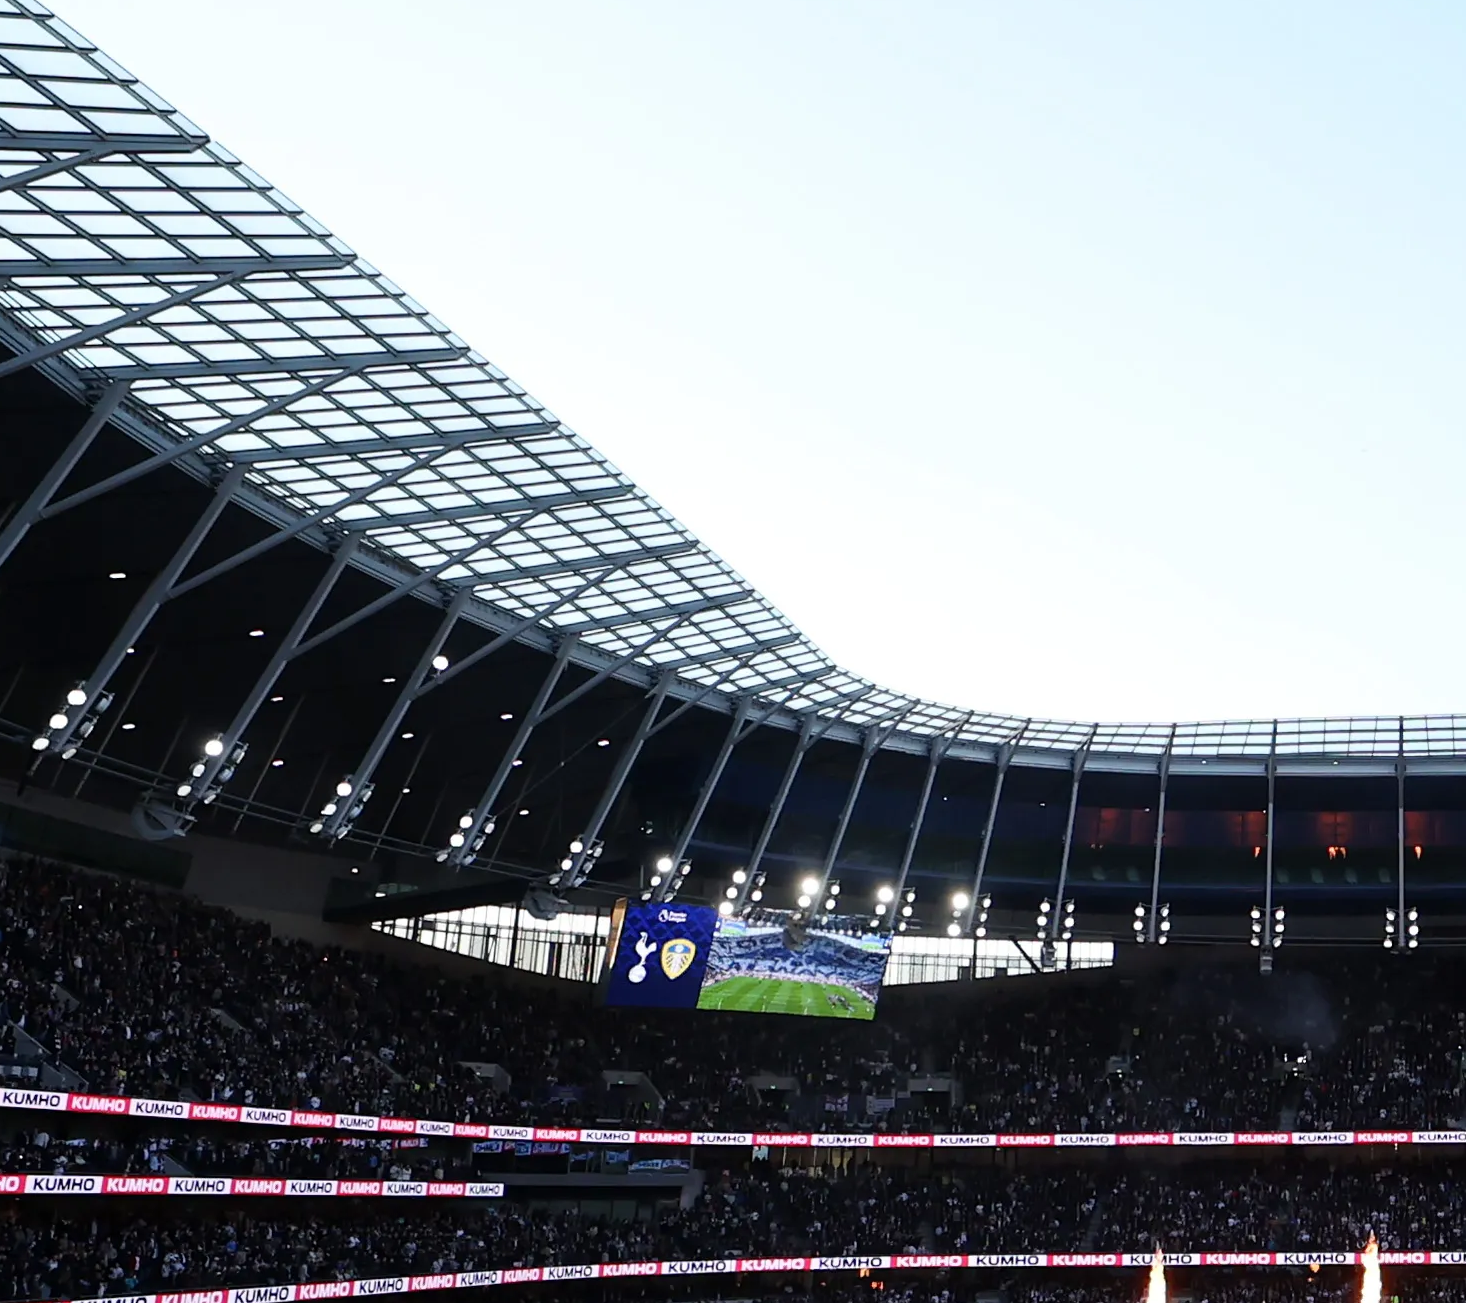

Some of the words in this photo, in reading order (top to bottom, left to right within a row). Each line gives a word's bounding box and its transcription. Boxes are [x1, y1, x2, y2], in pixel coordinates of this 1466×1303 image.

[2, 1091, 61, 1108] KUMHO
[71, 1095, 126, 1113] KUMHO
[756, 1135, 808, 1145] KUMHO
[878, 1136, 930, 1145] KUMHO
[33, 1177, 95, 1191] KUMHO
[107, 1178, 164, 1193] KUMHO
[741, 1258, 805, 1271] KUMHO
[819, 1257, 882, 1269] KUMHO
[896, 1256, 962, 1267] KUMHO
[976, 1255, 1039, 1266] KUMHO
[1053, 1254, 1117, 1266] KUMHO
[1206, 1253, 1270, 1264] KUMHO
[1284, 1253, 1347, 1264] KUMHO
[603, 1263, 657, 1276] KUMHO
[668, 1260, 727, 1274] KUMHO
